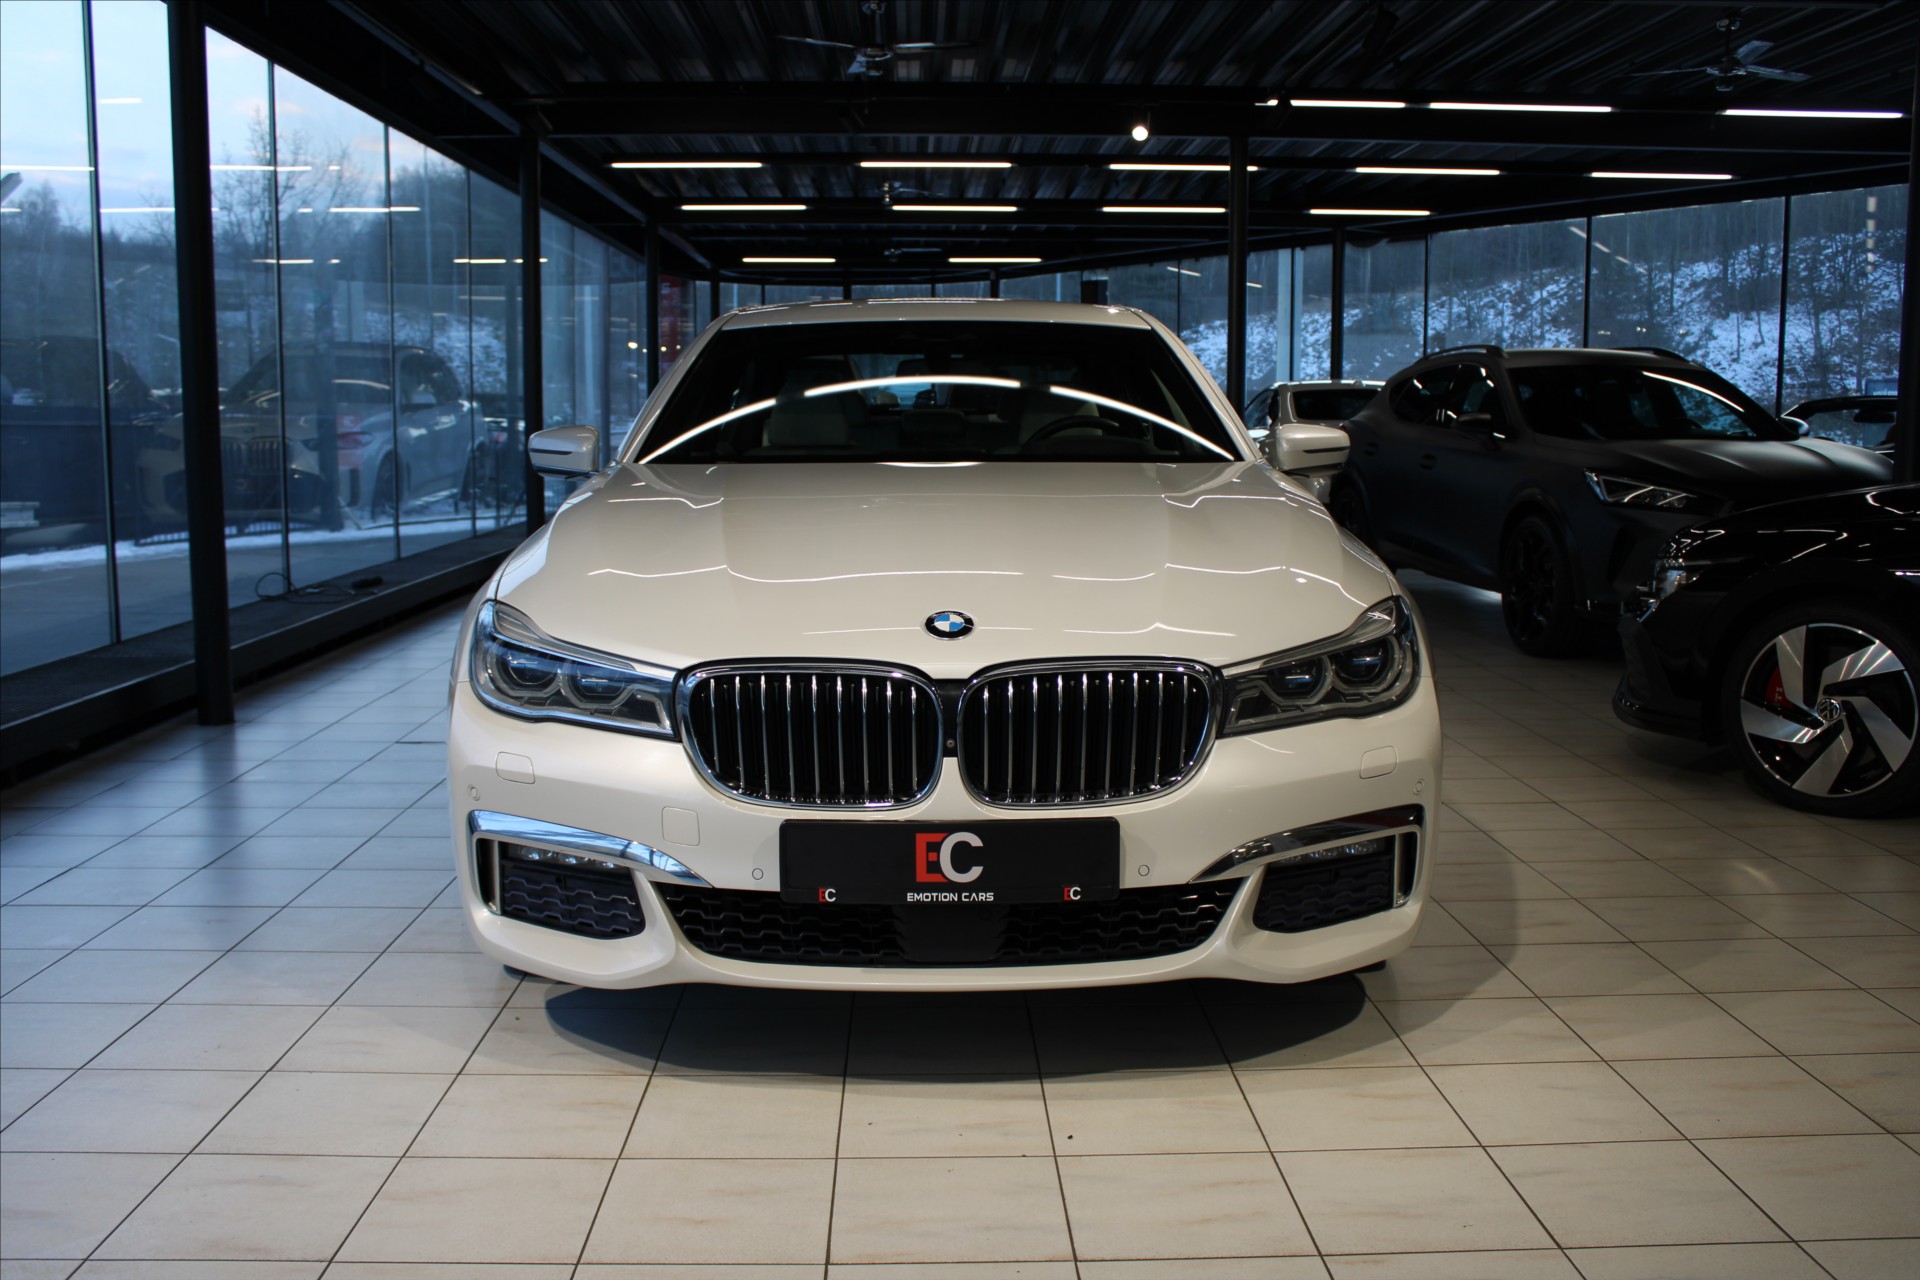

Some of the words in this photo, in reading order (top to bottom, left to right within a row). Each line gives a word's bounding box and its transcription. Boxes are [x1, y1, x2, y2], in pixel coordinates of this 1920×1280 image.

[915, 831, 984, 883] EC
[819, 888, 837, 902] EC
[907, 892, 958, 902] EMOTION
[962, 892, 994, 902] CARS
[1064, 887, 1081, 900] EC
